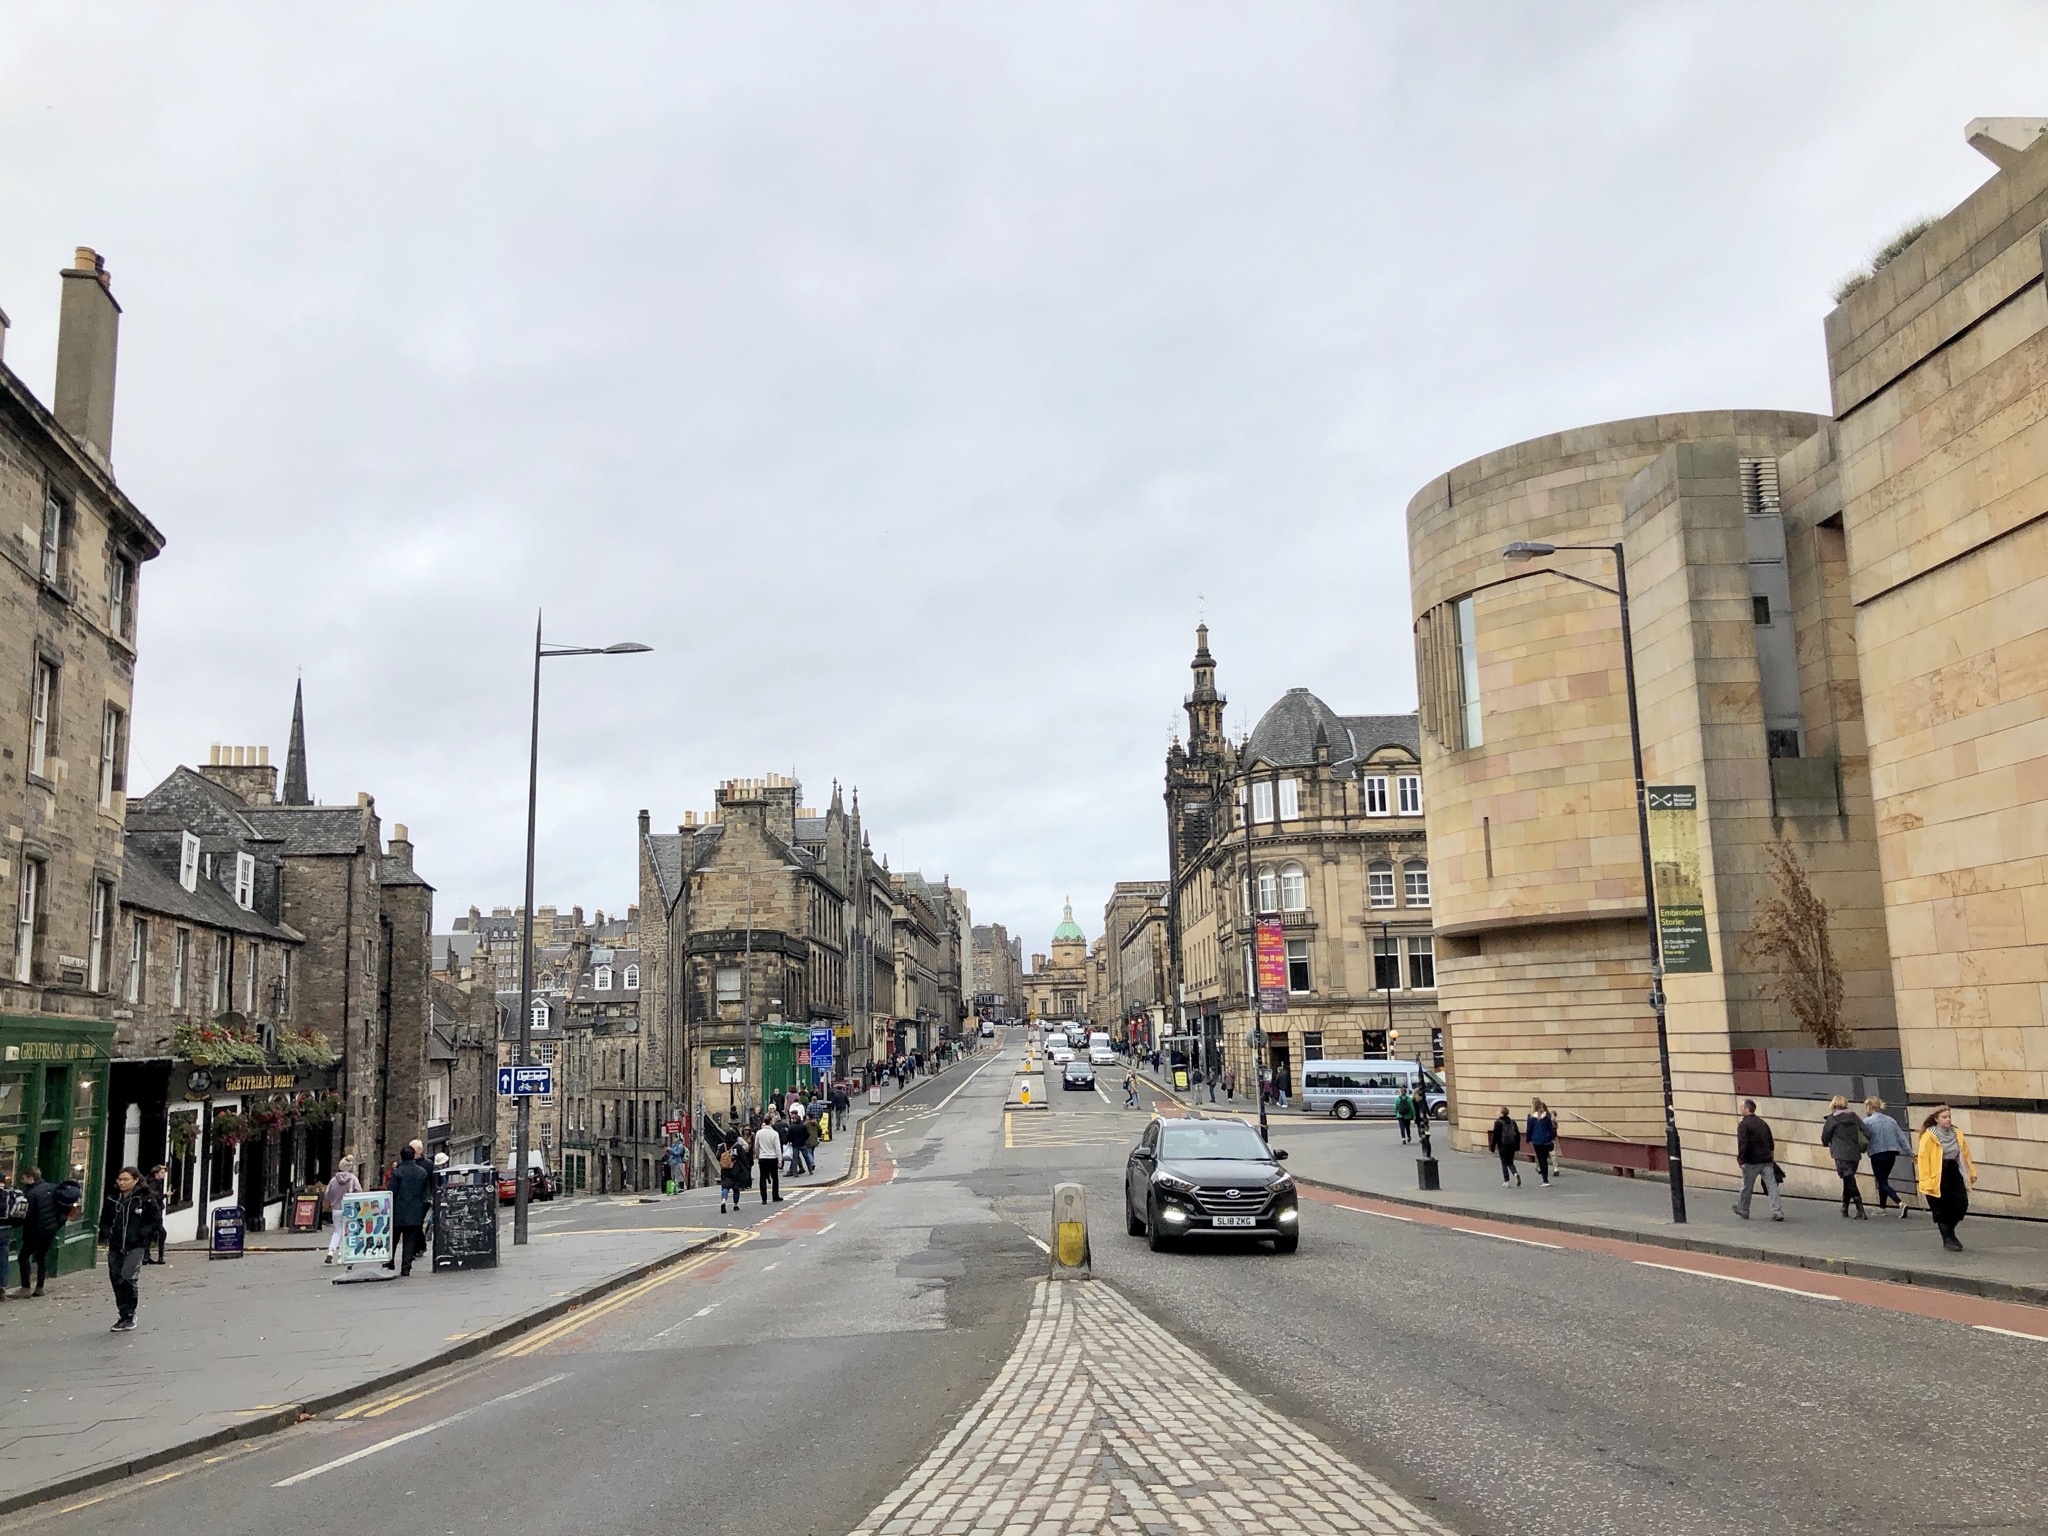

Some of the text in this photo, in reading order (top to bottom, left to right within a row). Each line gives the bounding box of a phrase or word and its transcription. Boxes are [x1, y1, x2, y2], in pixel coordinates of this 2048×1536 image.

[21, 1042, 63, 1059] GREYFRIARS
[65, 1044, 80, 1059] ART
[226, 1075, 295, 1091] GREYFRIARS BOBBY
[1217, 1217, 1251, 1225] SL18 ZKG
